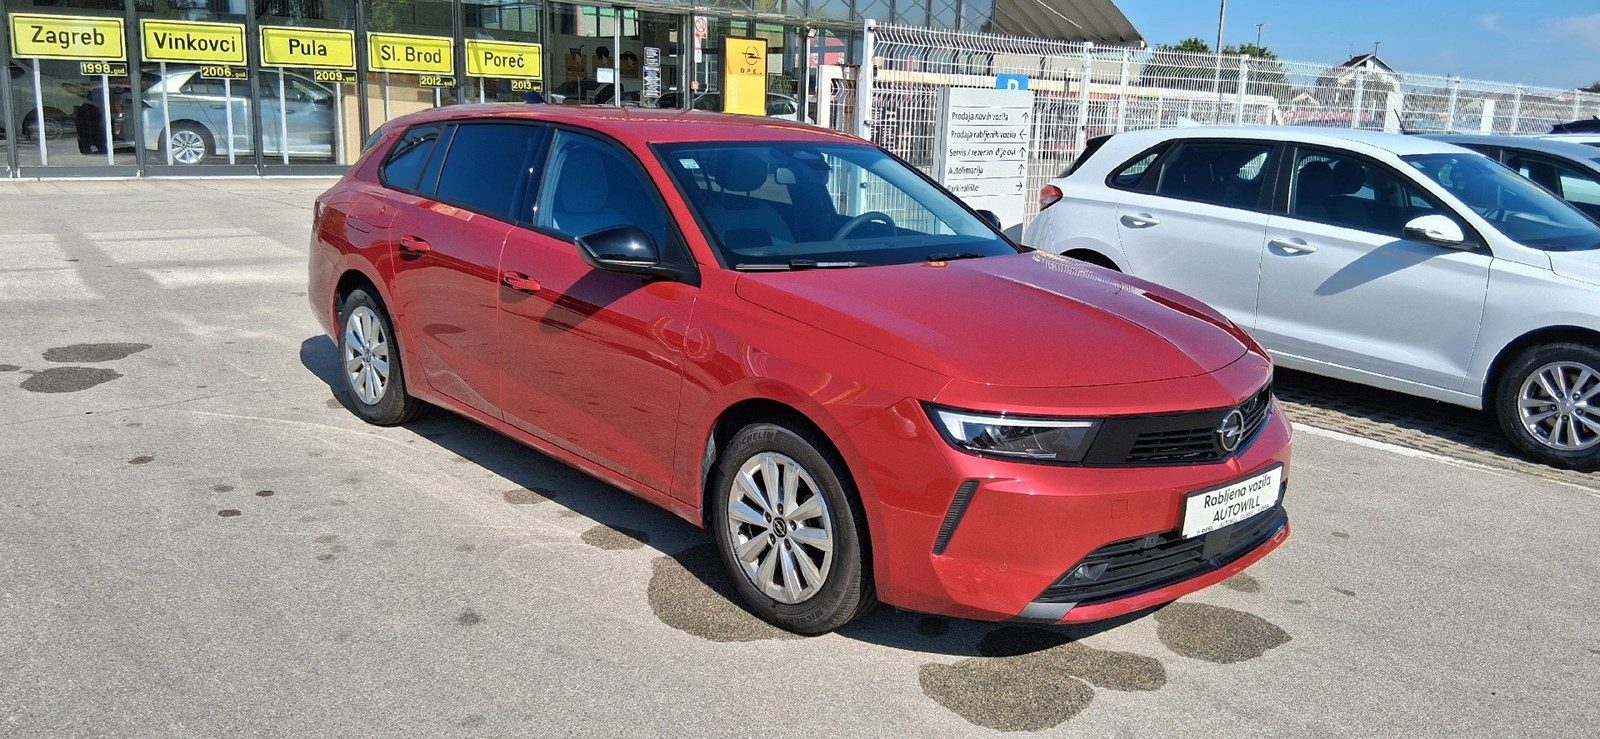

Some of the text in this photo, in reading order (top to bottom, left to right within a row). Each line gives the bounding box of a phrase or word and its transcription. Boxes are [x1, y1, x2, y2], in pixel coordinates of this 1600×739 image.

[31, 25, 105, 49] Zagreb
[153, 31, 236, 53] Vinkovci
[288, 38, 328, 56] Pula
[381, 44, 442, 64] Sl. Brod
[484, 51, 525, 68] Poreč
[951, 112, 975, 123] Prodaja
[975, 112, 992, 121] novih
[951, 130, 973, 141] Prodaja
[949, 148, 967, 157] Servis
[1203, 474, 1271, 508] Rabljena vozila
[1212, 495, 1261, 523] AUTOWILL
